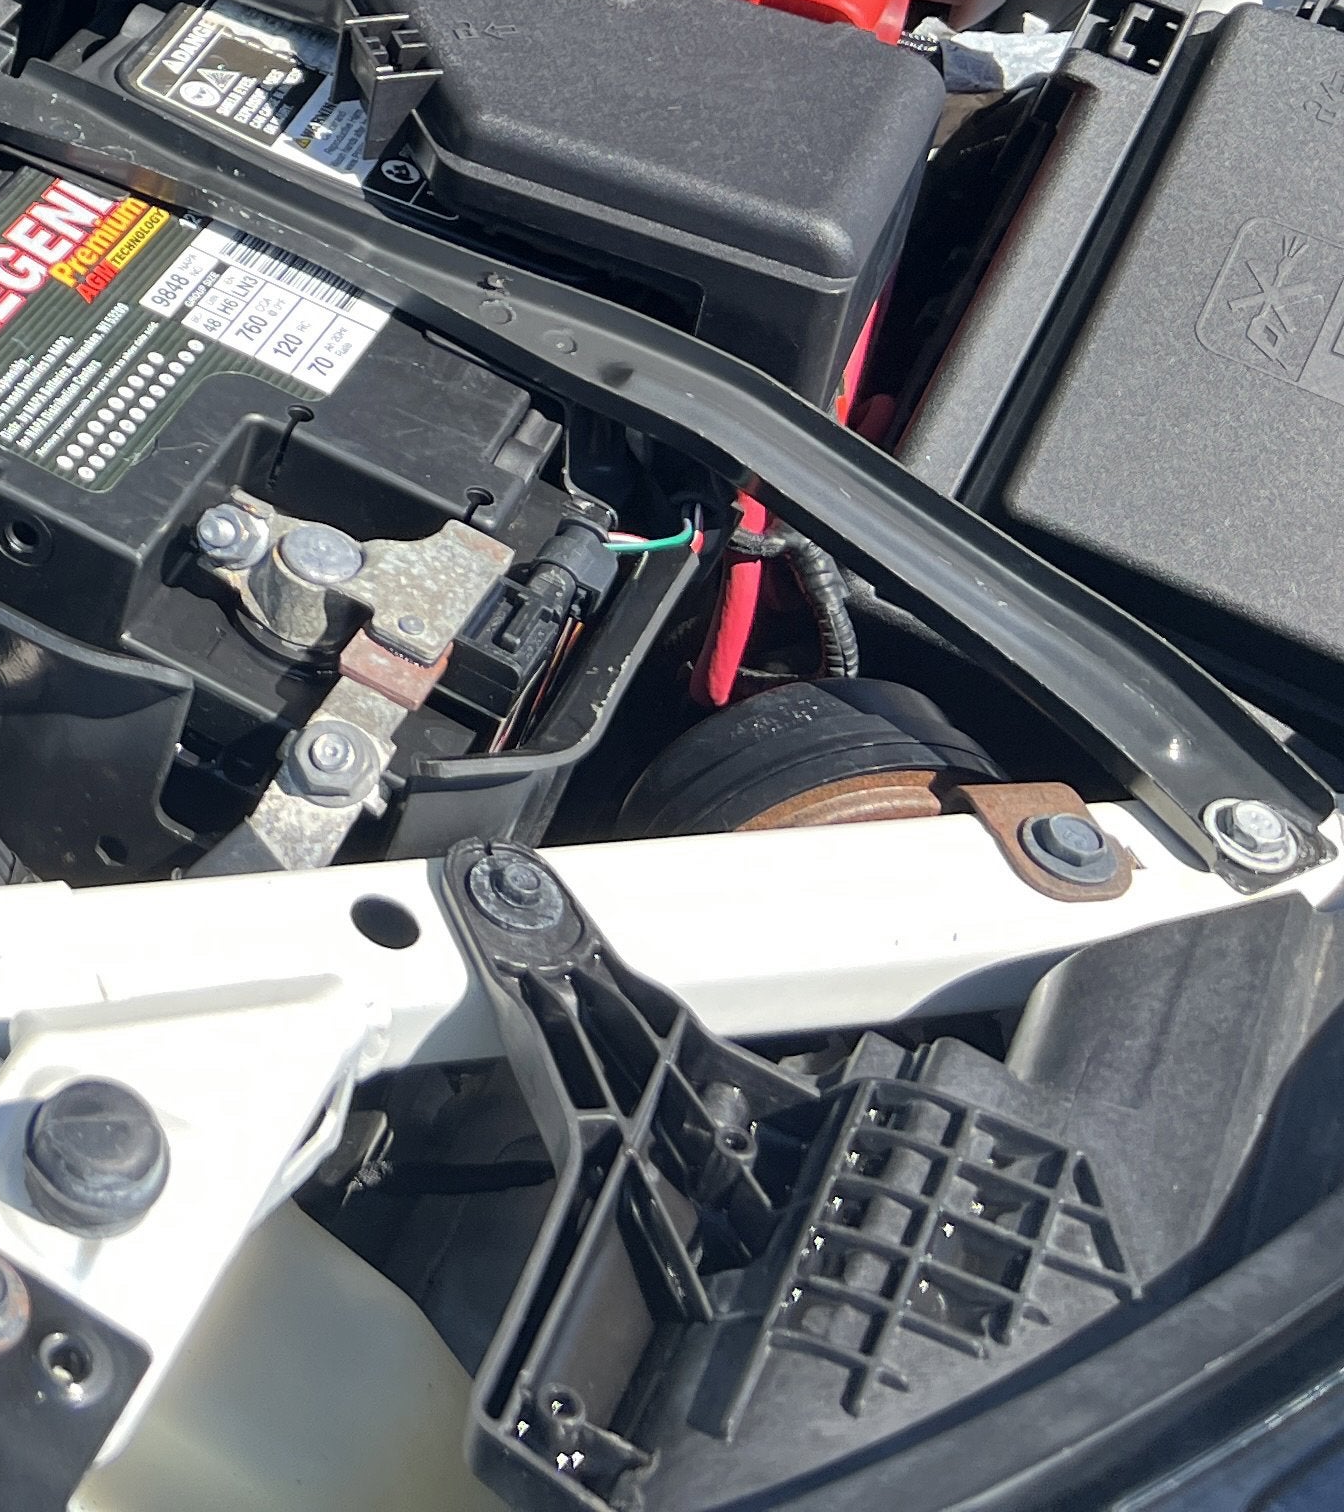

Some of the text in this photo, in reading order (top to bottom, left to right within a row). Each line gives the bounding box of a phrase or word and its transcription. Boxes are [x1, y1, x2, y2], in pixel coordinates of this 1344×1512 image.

[171, 18, 220, 62] DANGE
[48, 196, 150, 287] Premium
[111, 209, 167, 266] TECHNOLOGY
[76, 258, 120, 304] AGM
[151, 274, 190, 308] 9848
[184, 271, 221, 308] GROUP SIZE
[233, 275, 259, 298] LN3
[217, 298, 240, 315] H6
[202, 317, 222, 333] 48
[235, 315, 268, 342] 760
[273, 333, 304, 358] 120
[17, 360, 50, 390] batteries
[307, 356, 334, 376] 70
[23, 393, 48, 414] NAPA
[24, 418, 48, 440] NAPA
[41, 382, 80, 422] Distribution
[72, 359, 102, 386] Centers
